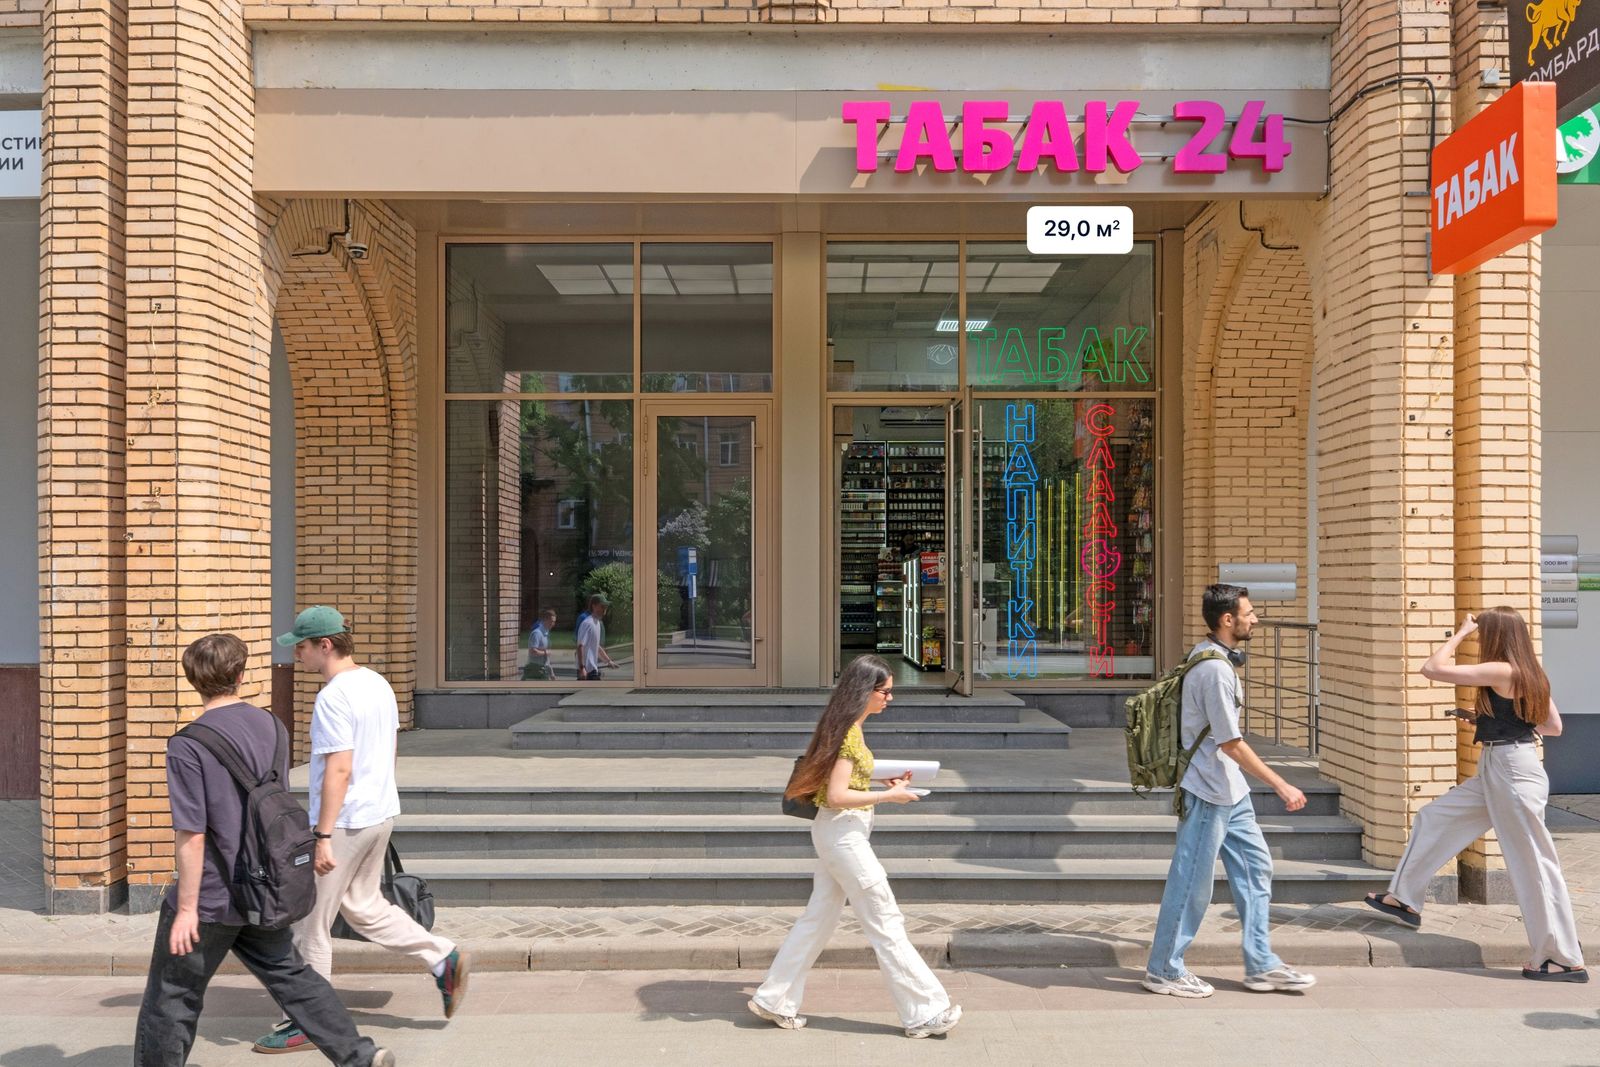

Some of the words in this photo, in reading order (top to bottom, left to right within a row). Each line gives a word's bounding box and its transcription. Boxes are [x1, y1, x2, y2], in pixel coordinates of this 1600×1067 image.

[842, 101, 1144, 173] ТАБАК
[1173, 101, 1292, 173] 24
[1434, 132, 1520, 231] ТАБАК
[969, 327, 1150, 384] ТАБАК
[1004, 404, 1038, 679] НАПИТКИ
